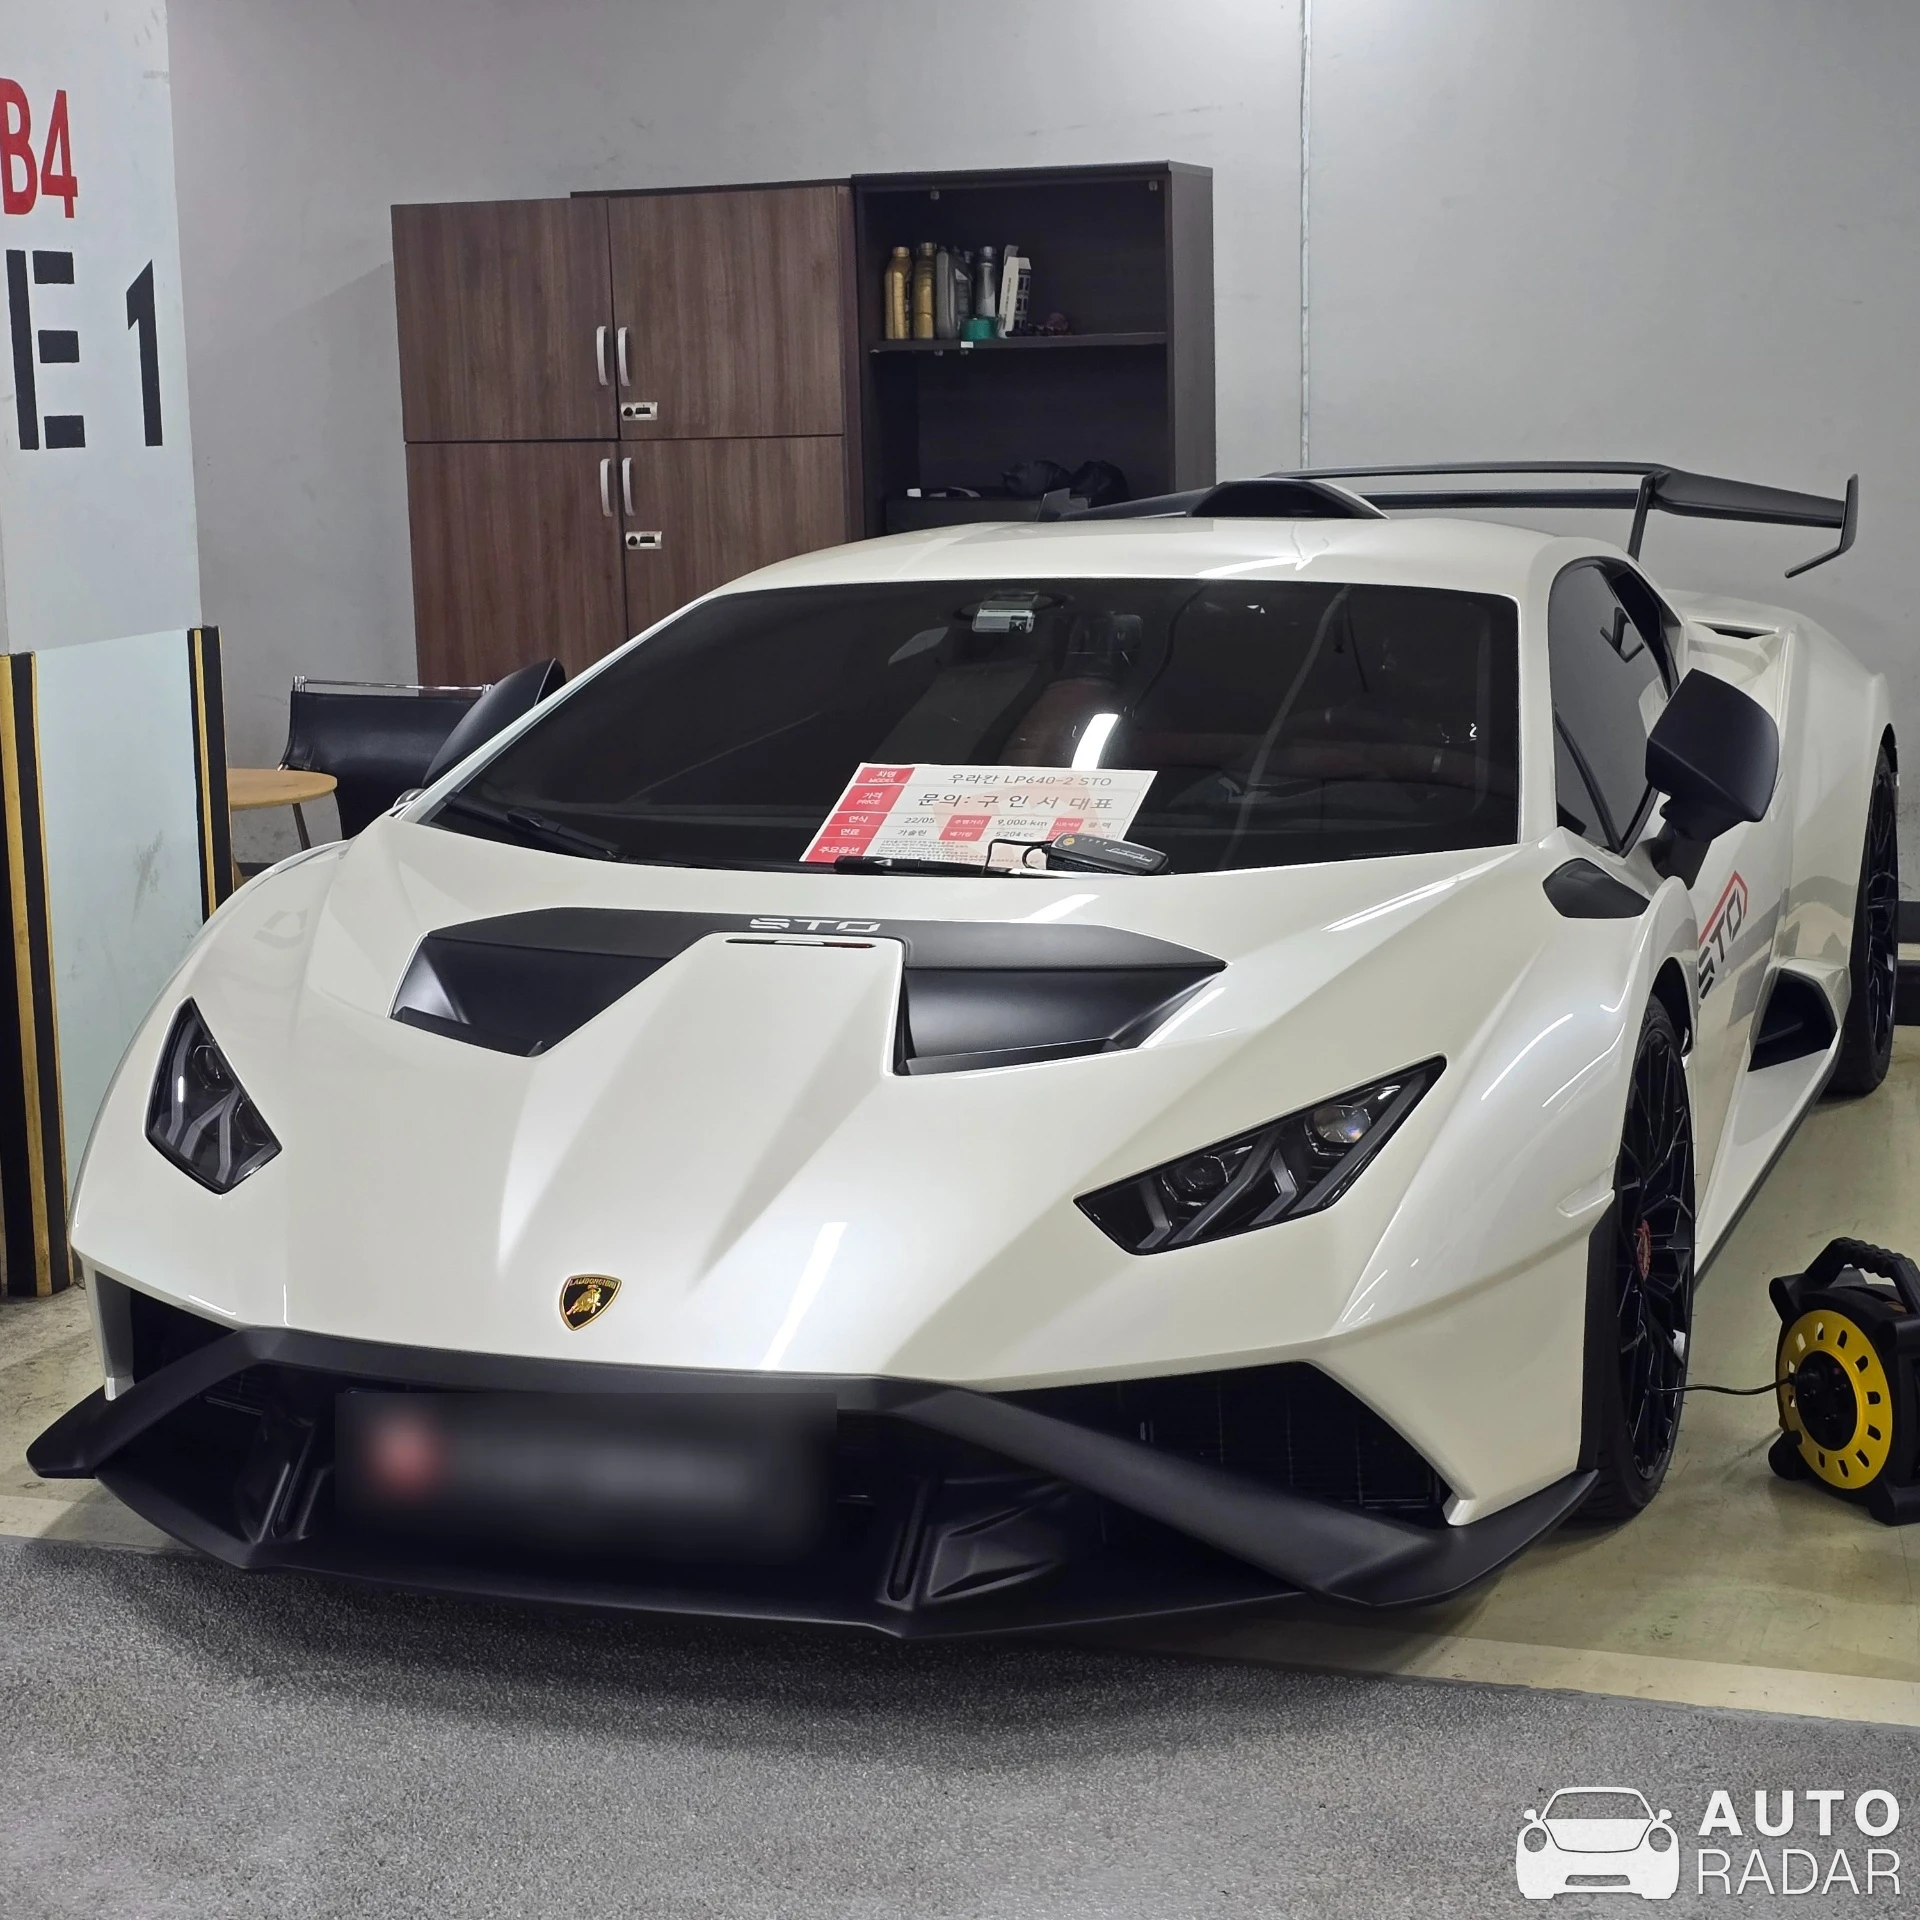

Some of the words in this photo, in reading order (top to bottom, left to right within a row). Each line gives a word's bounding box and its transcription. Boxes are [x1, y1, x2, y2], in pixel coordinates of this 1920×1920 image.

[0, 78, 78, 218] B4
[6, 249, 86, 450] E
[126, 259, 163, 446] 1
[948, 773, 999, 785] 우라칸
[1003, 774, 1074, 786] LP640-2
[1078, 776, 1112, 787] STO
[862, 791, 883, 799] 가격
[918, 793, 971, 808] 문의:
[977, 795, 1000, 808] 구
[1009, 794, 1029, 808] 인
[1037, 796, 1059, 809] 서
[1069, 797, 1113, 810] 대표
[848, 815, 868, 823] 연식
[1030, 819, 1048, 827] km
[840, 828, 860, 836] 연료
[897, 829, 927, 837] 가솔린
[818, 846, 860, 855] 주요옵션
[750, 917, 881, 933] STO
[1698, 888, 1742, 1000] STO
